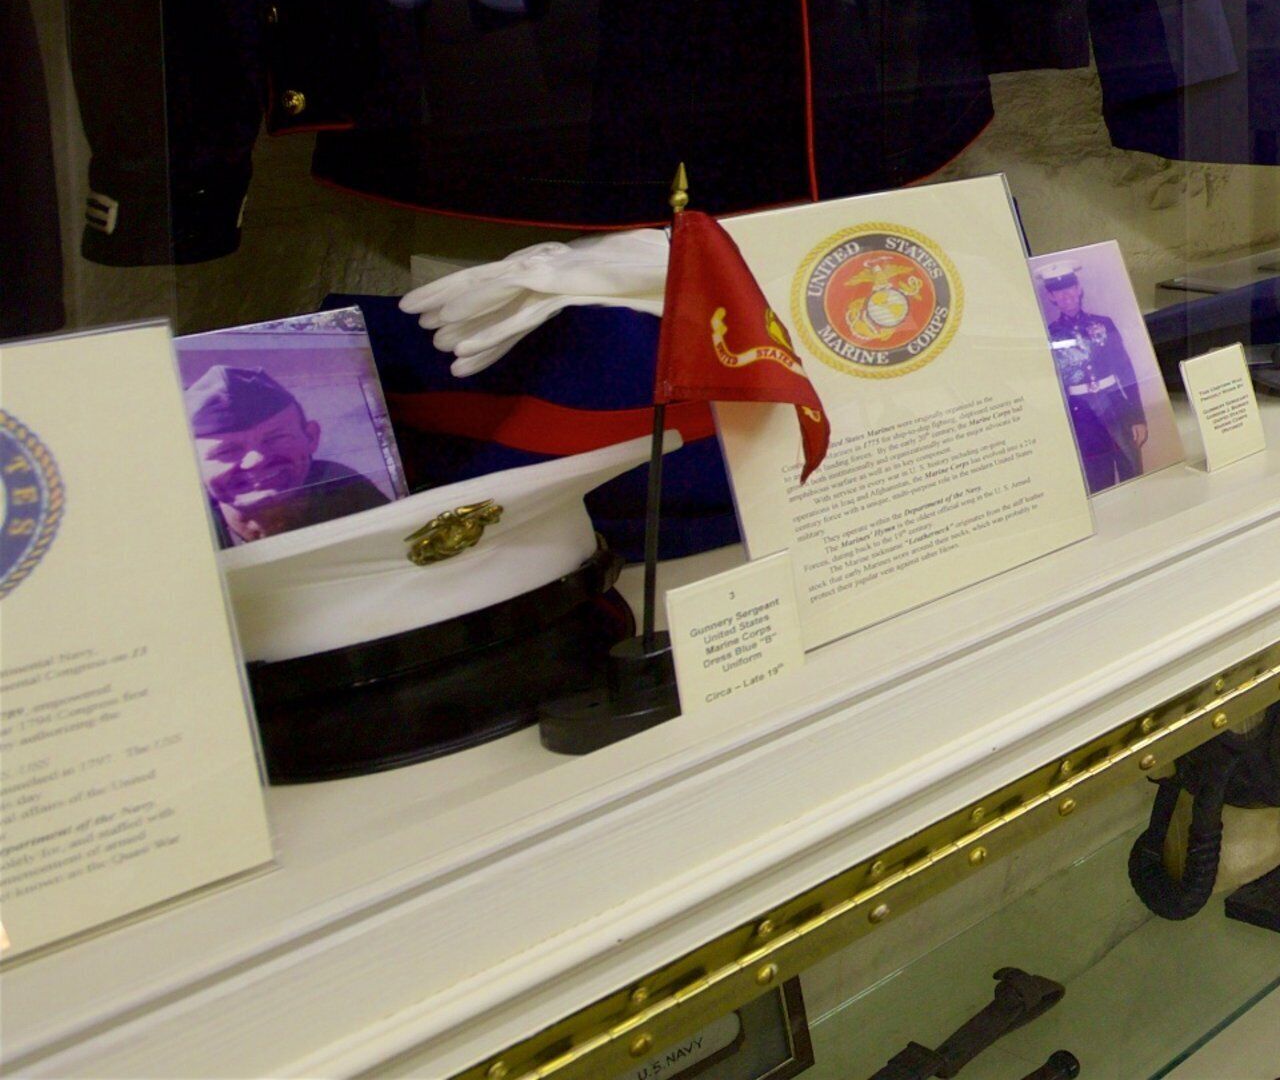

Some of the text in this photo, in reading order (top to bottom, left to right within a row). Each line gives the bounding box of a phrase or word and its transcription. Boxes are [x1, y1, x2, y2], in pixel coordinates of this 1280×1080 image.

[807, 236, 943, 296] UNITED STATES
[818, 306, 948, 364] MARINE CORPS
[727, 588, 736, 601] 3
[688, 595, 780, 641] Gunnery Sergeant
[703, 610, 770, 646] United States
[702, 648, 732, 669] Dress
[734, 638, 757, 657] Blue
[704, 621, 771, 657] Marine Corps
[721, 647, 762, 675] Uniform
[705, 687, 732, 703] Circa
[743, 674, 764, 688] Late
[666, 1037, 704, 1067] NAVY
